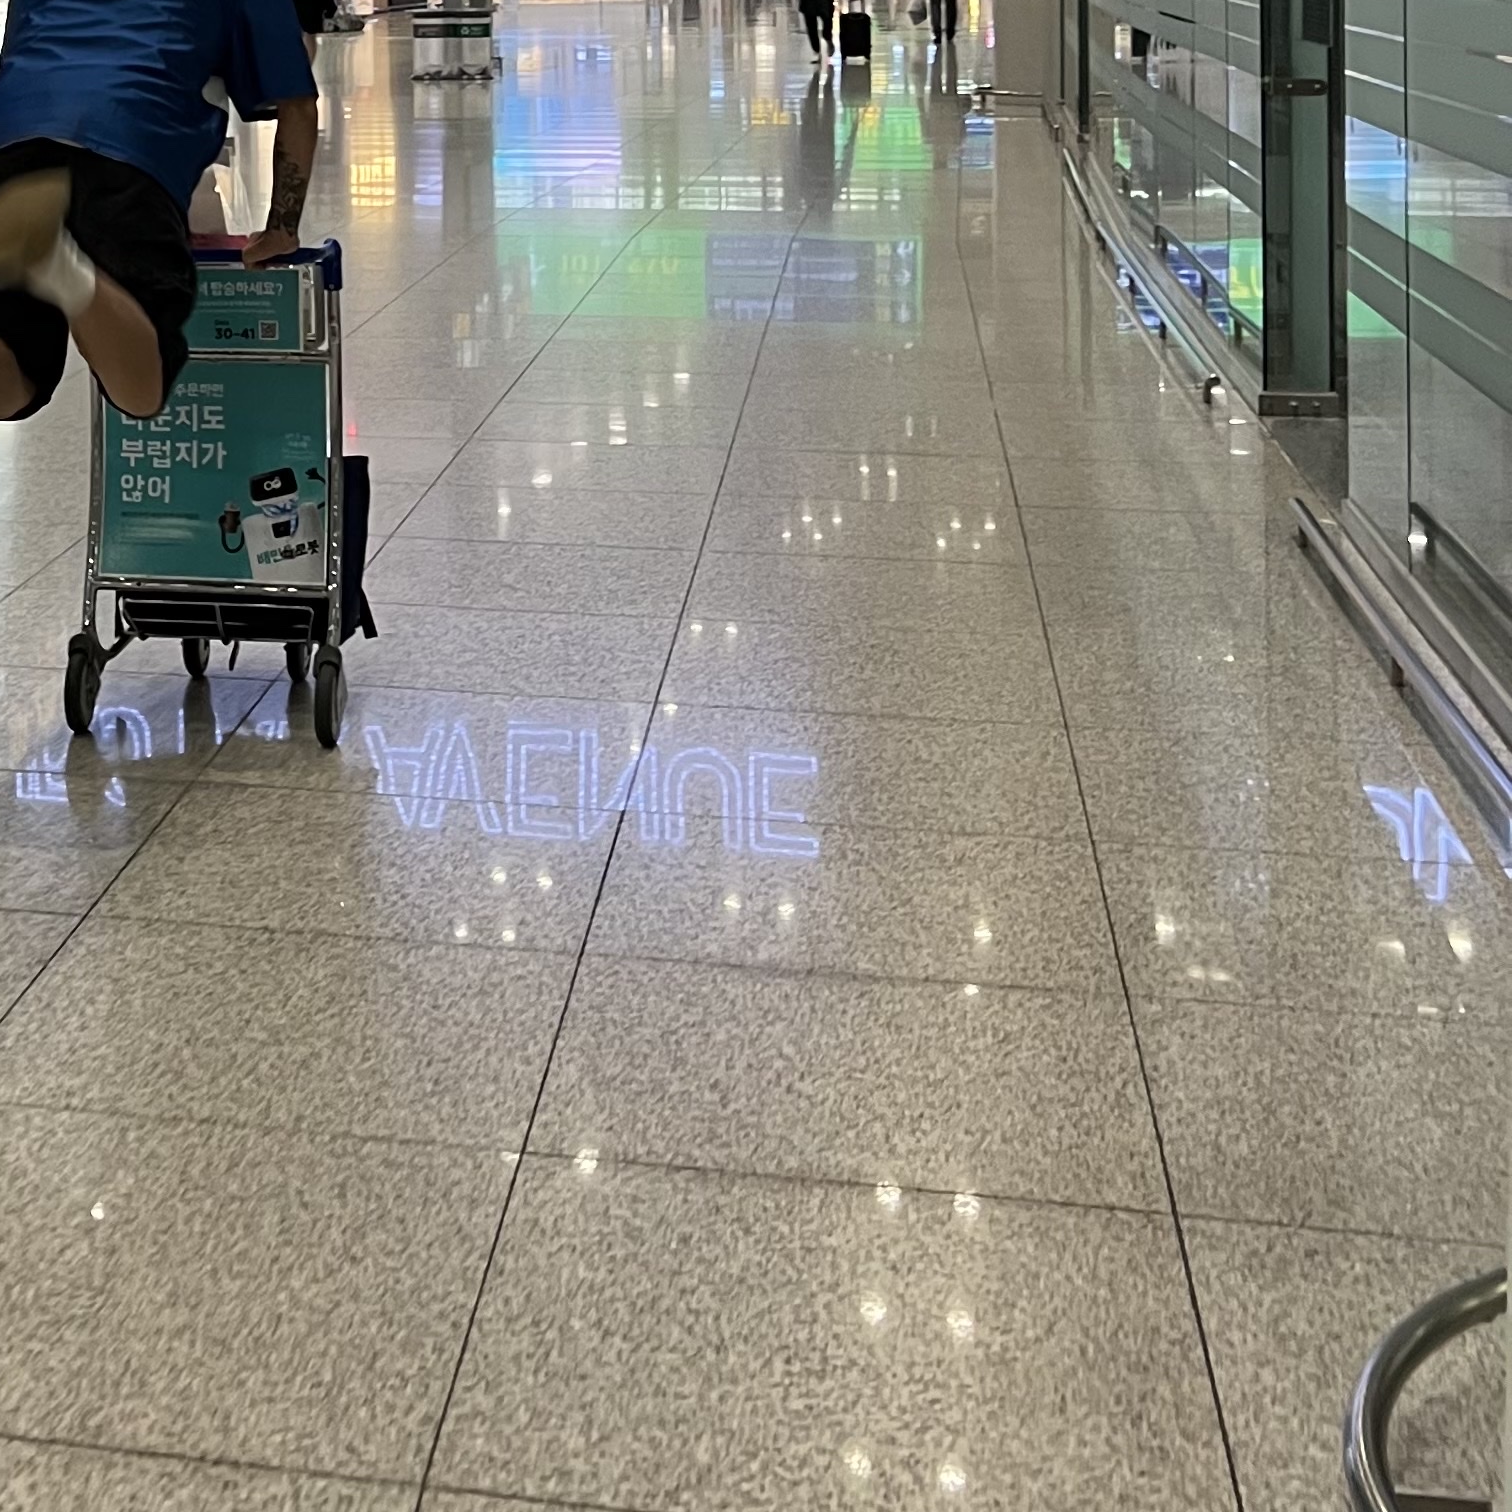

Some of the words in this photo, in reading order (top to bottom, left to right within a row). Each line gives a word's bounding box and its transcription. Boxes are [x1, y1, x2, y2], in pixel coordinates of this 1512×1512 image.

[214, 327, 256, 341] 30-41
[120, 438, 228, 470] 부럽지가
[120, 473, 171, 504] 않어
